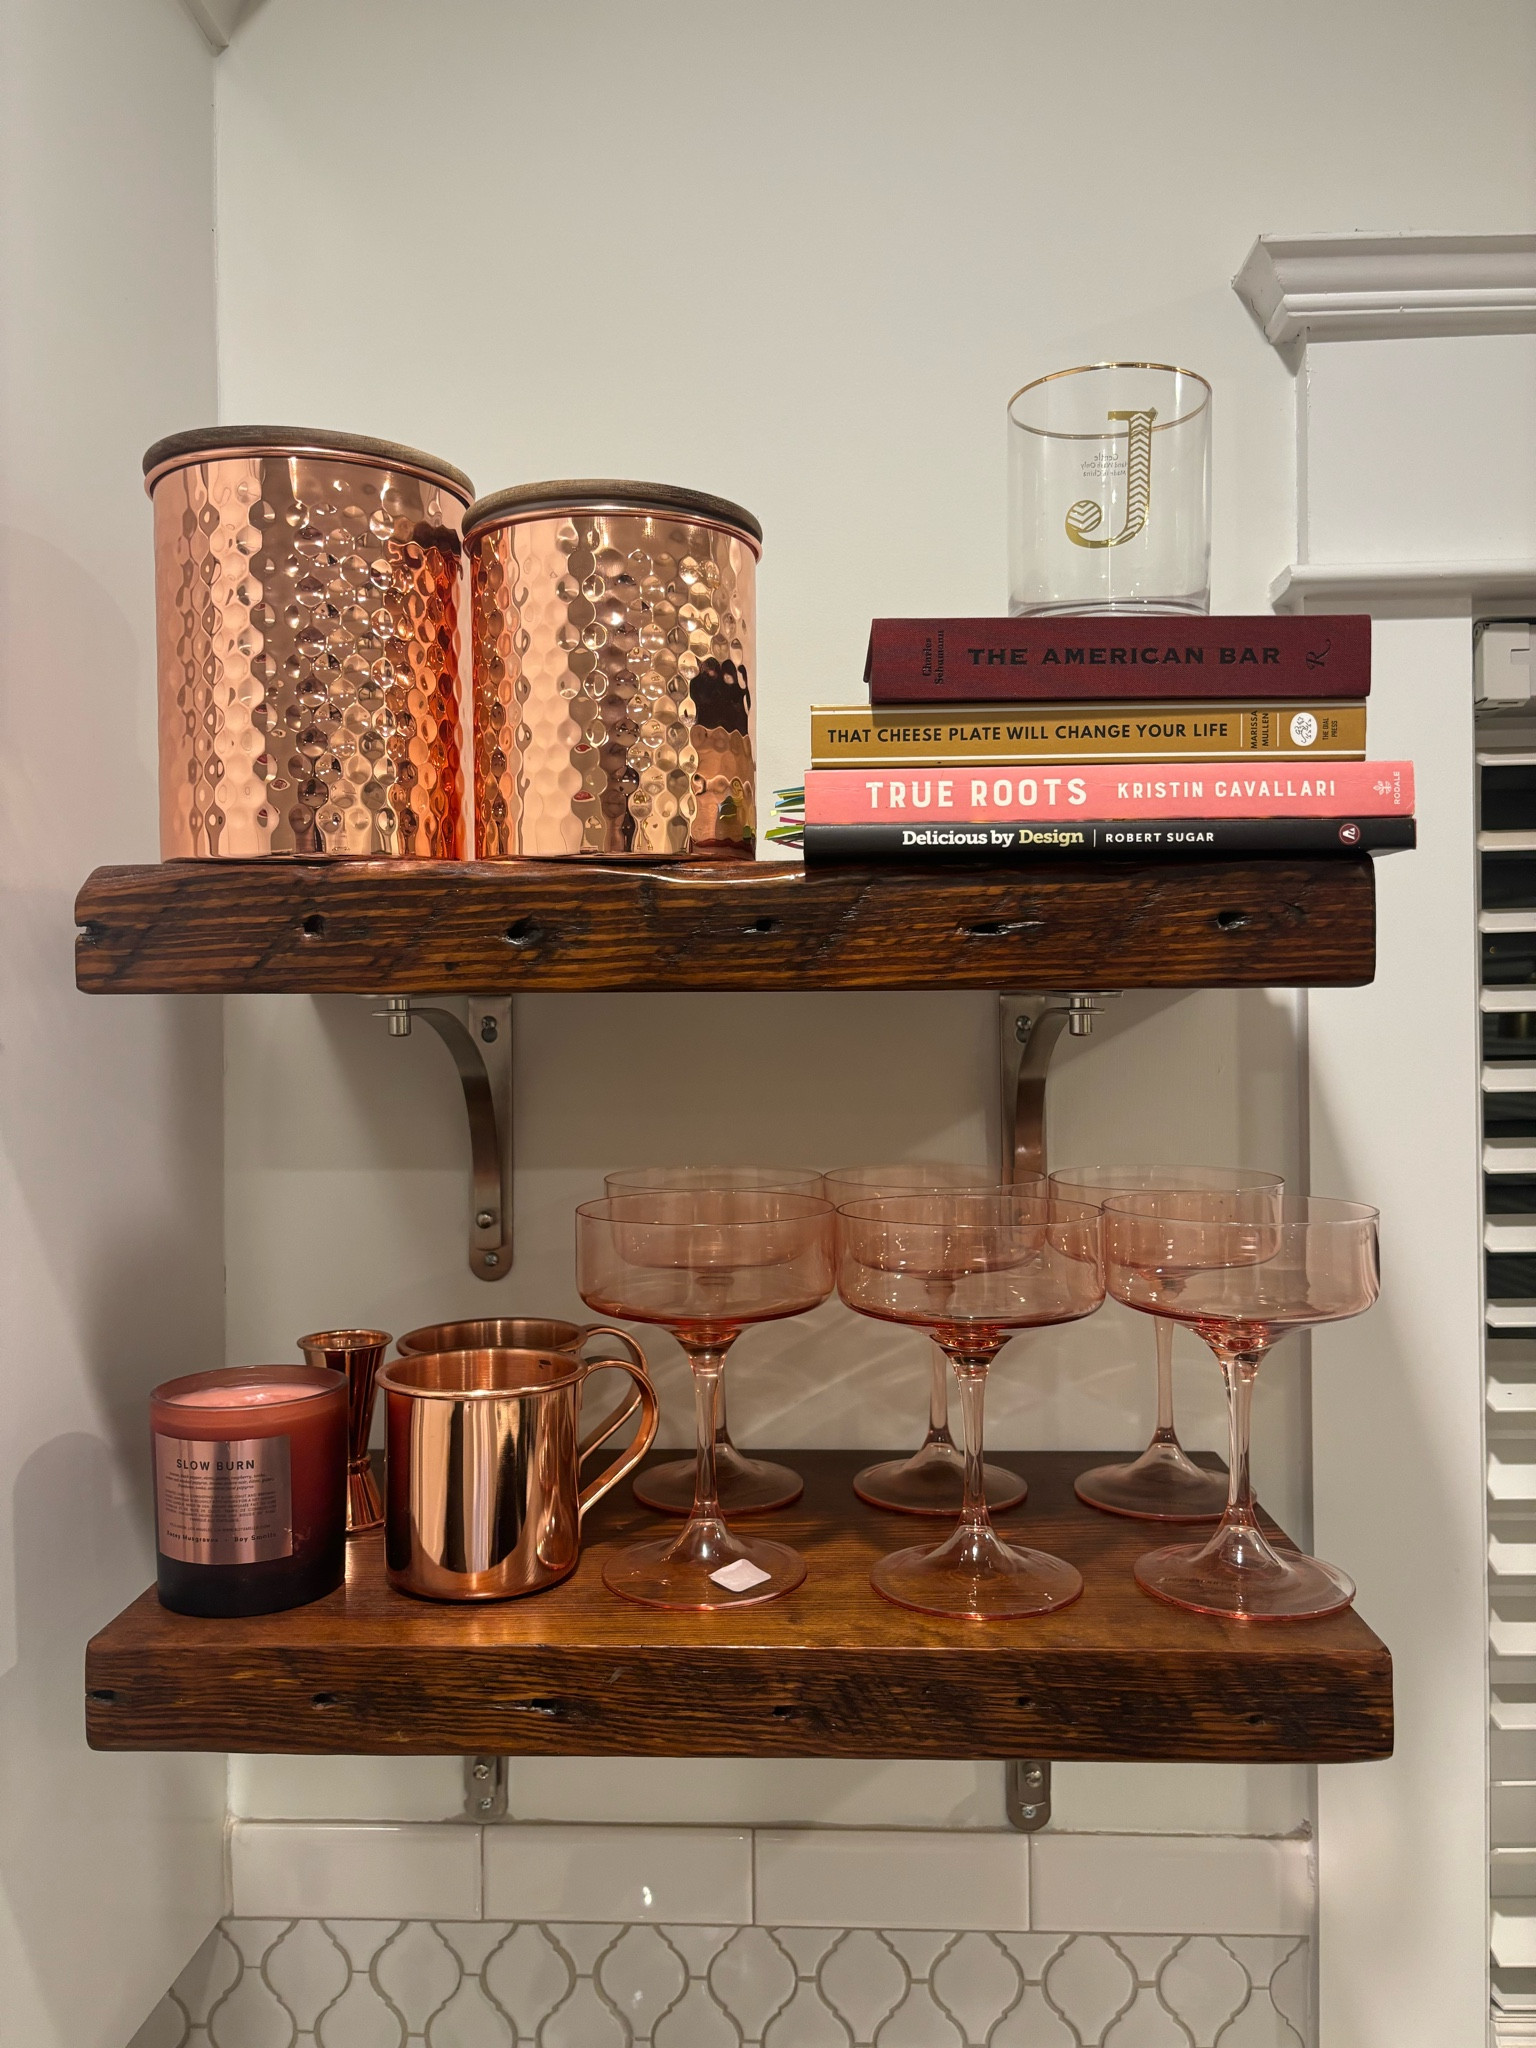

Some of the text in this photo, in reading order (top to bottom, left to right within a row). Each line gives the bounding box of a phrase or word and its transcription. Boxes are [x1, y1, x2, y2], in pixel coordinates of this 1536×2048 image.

[1065, 407, 1158, 549] J
[922, 638, 932, 677] Charles
[934, 630, 944, 685] Schumann
[968, 647, 1281, 666] THE AMERICAN BAR
[828, 722, 1228, 743] THAT CHEESE PLATE WILL CHANGE YOUR LIFE
[1250, 710, 1258, 749] MARISSA
[1261, 712, 1269, 747] MULLEN
[865, 778, 1087, 809] TRUE ROOTS
[1117, 780, 1336, 799] KRISTIN CAVALLARI
[1393, 771, 1401, 805] RODALE
[902, 829, 1085, 848] Delicious by Design
[1105, 831, 1215, 844] ROBERT SUGAR
[176, 1458, 255, 1471] SLOW BURN
